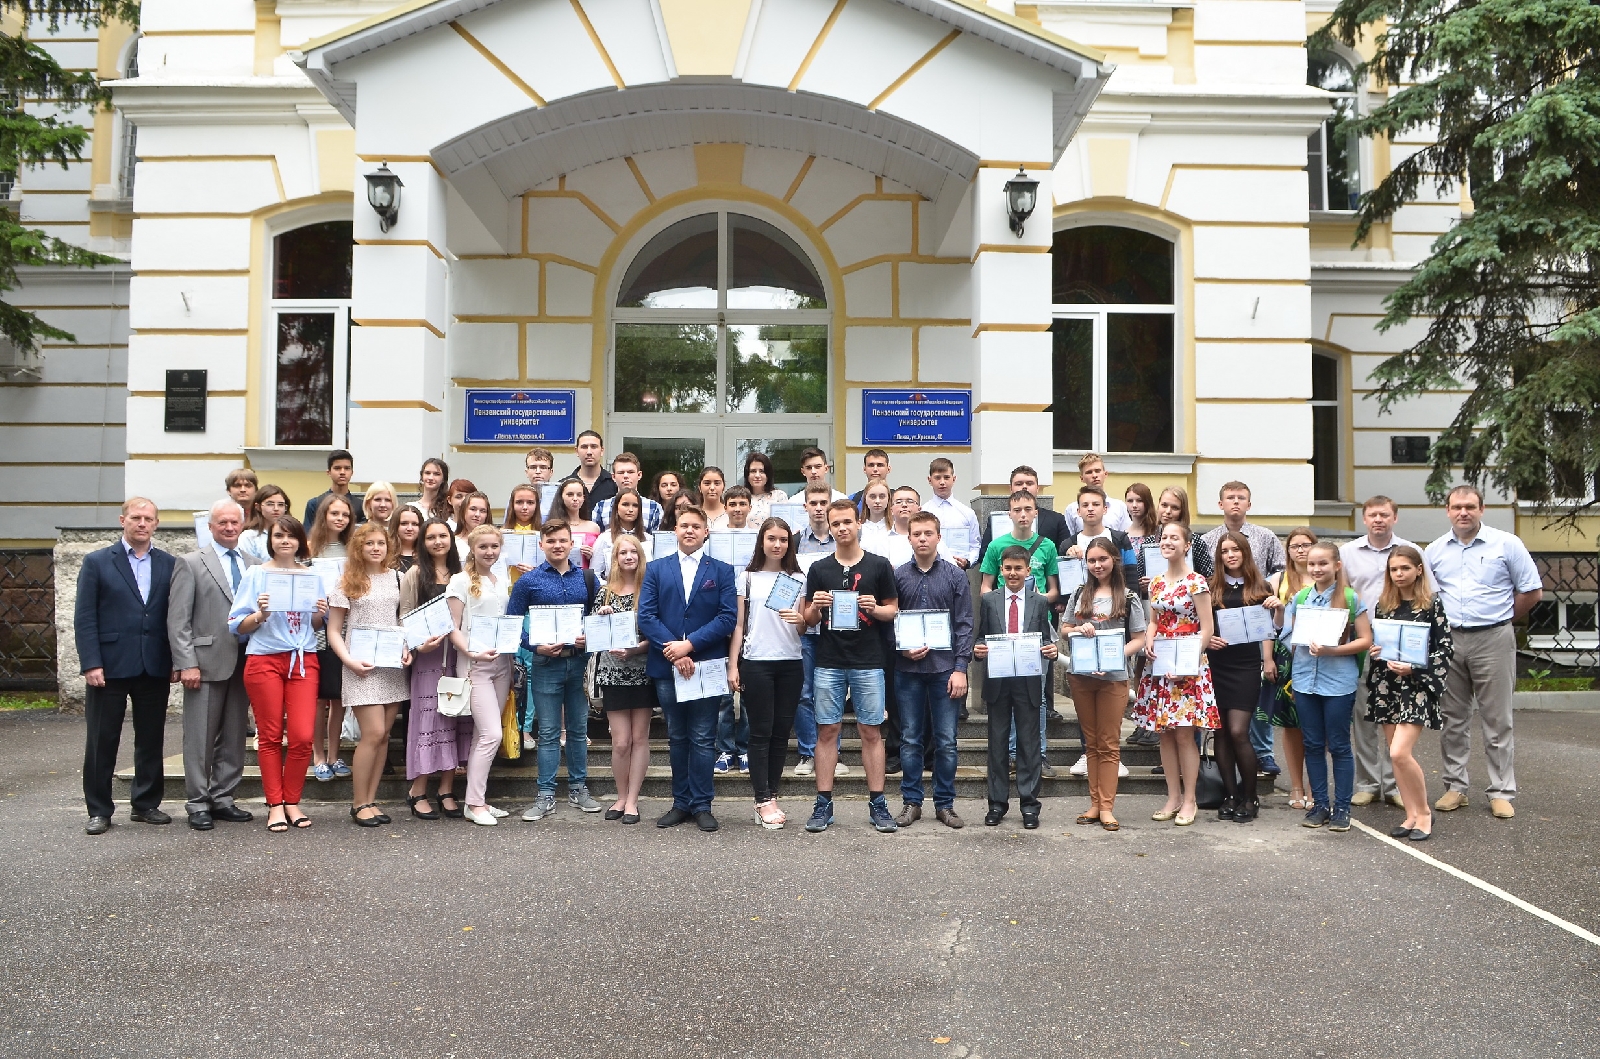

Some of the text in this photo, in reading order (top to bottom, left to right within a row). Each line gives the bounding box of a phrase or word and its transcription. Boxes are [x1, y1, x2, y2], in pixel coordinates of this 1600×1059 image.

[474, 408, 566, 417] Пензенский государственный
[872, 408, 964, 417] Пензенский государственный
